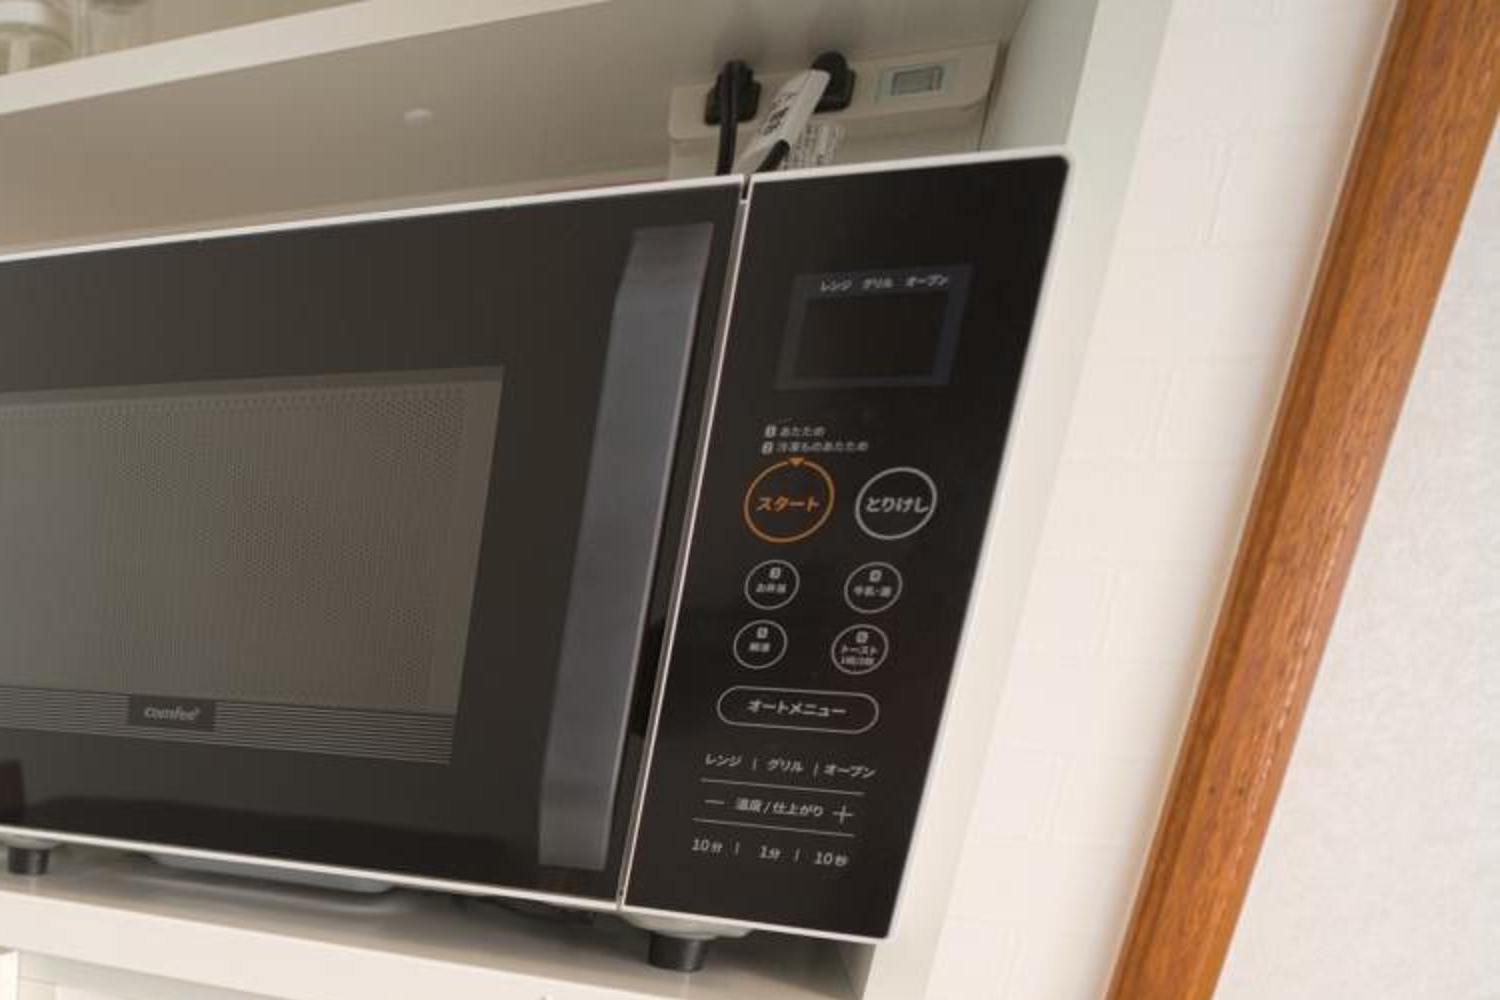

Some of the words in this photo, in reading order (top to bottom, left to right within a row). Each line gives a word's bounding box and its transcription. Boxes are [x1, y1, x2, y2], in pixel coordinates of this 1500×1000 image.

[819, 279, 852, 292] レンジ
[862, 277, 893, 290] グリル
[905, 274, 949, 288] オープン
[756, 496, 820, 512] スタート
[865, 496, 931, 513] とりけし
[748, 699, 847, 717] オートメニュー
[704, 754, 743, 767] レンジ
[767, 757, 804, 772] グリル
[822, 763, 877, 779] オープン
[692, 838, 724, 852] 10分
[759, 845, 781, 860] 1分
[814, 851, 849, 867] 10秒
